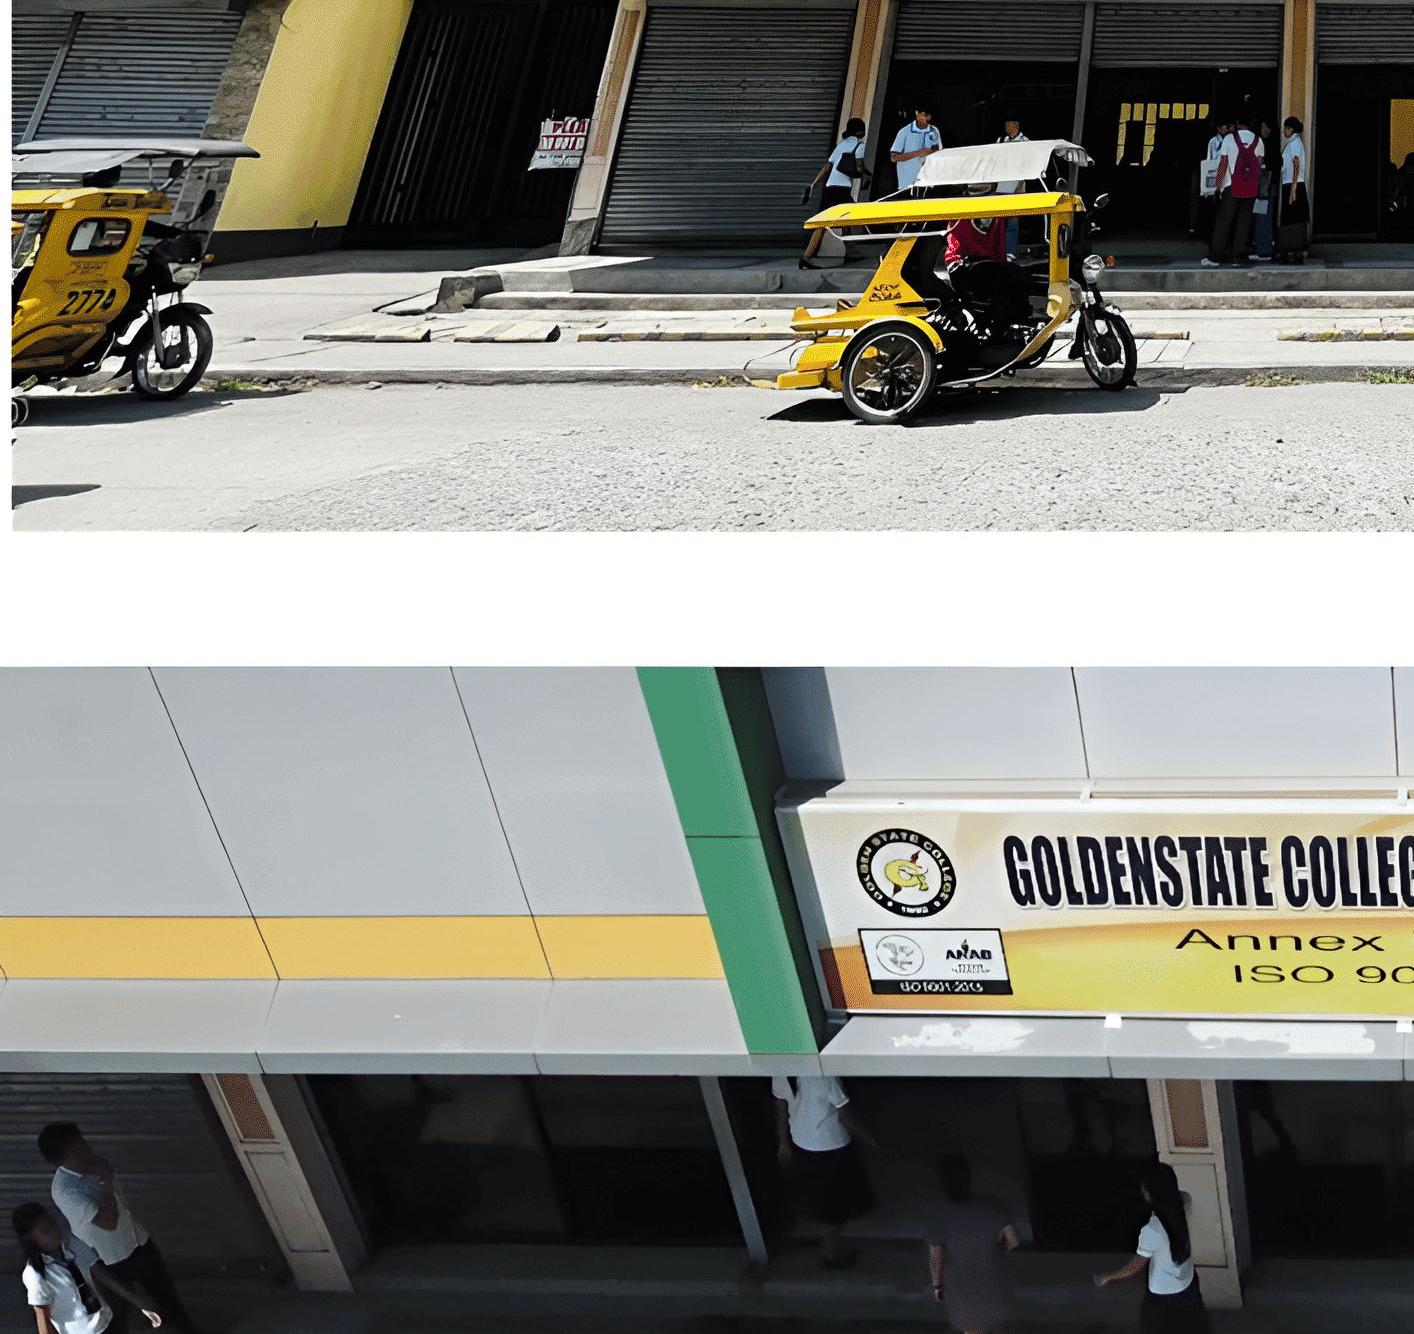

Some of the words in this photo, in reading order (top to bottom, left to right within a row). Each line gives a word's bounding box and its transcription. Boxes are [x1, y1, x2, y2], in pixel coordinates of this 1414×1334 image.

[1004, 834, 1276, 908] GOLDENSTATE
[1175, 928, 1385, 952] Annex
[1233, 965, 1335, 984] ISO
